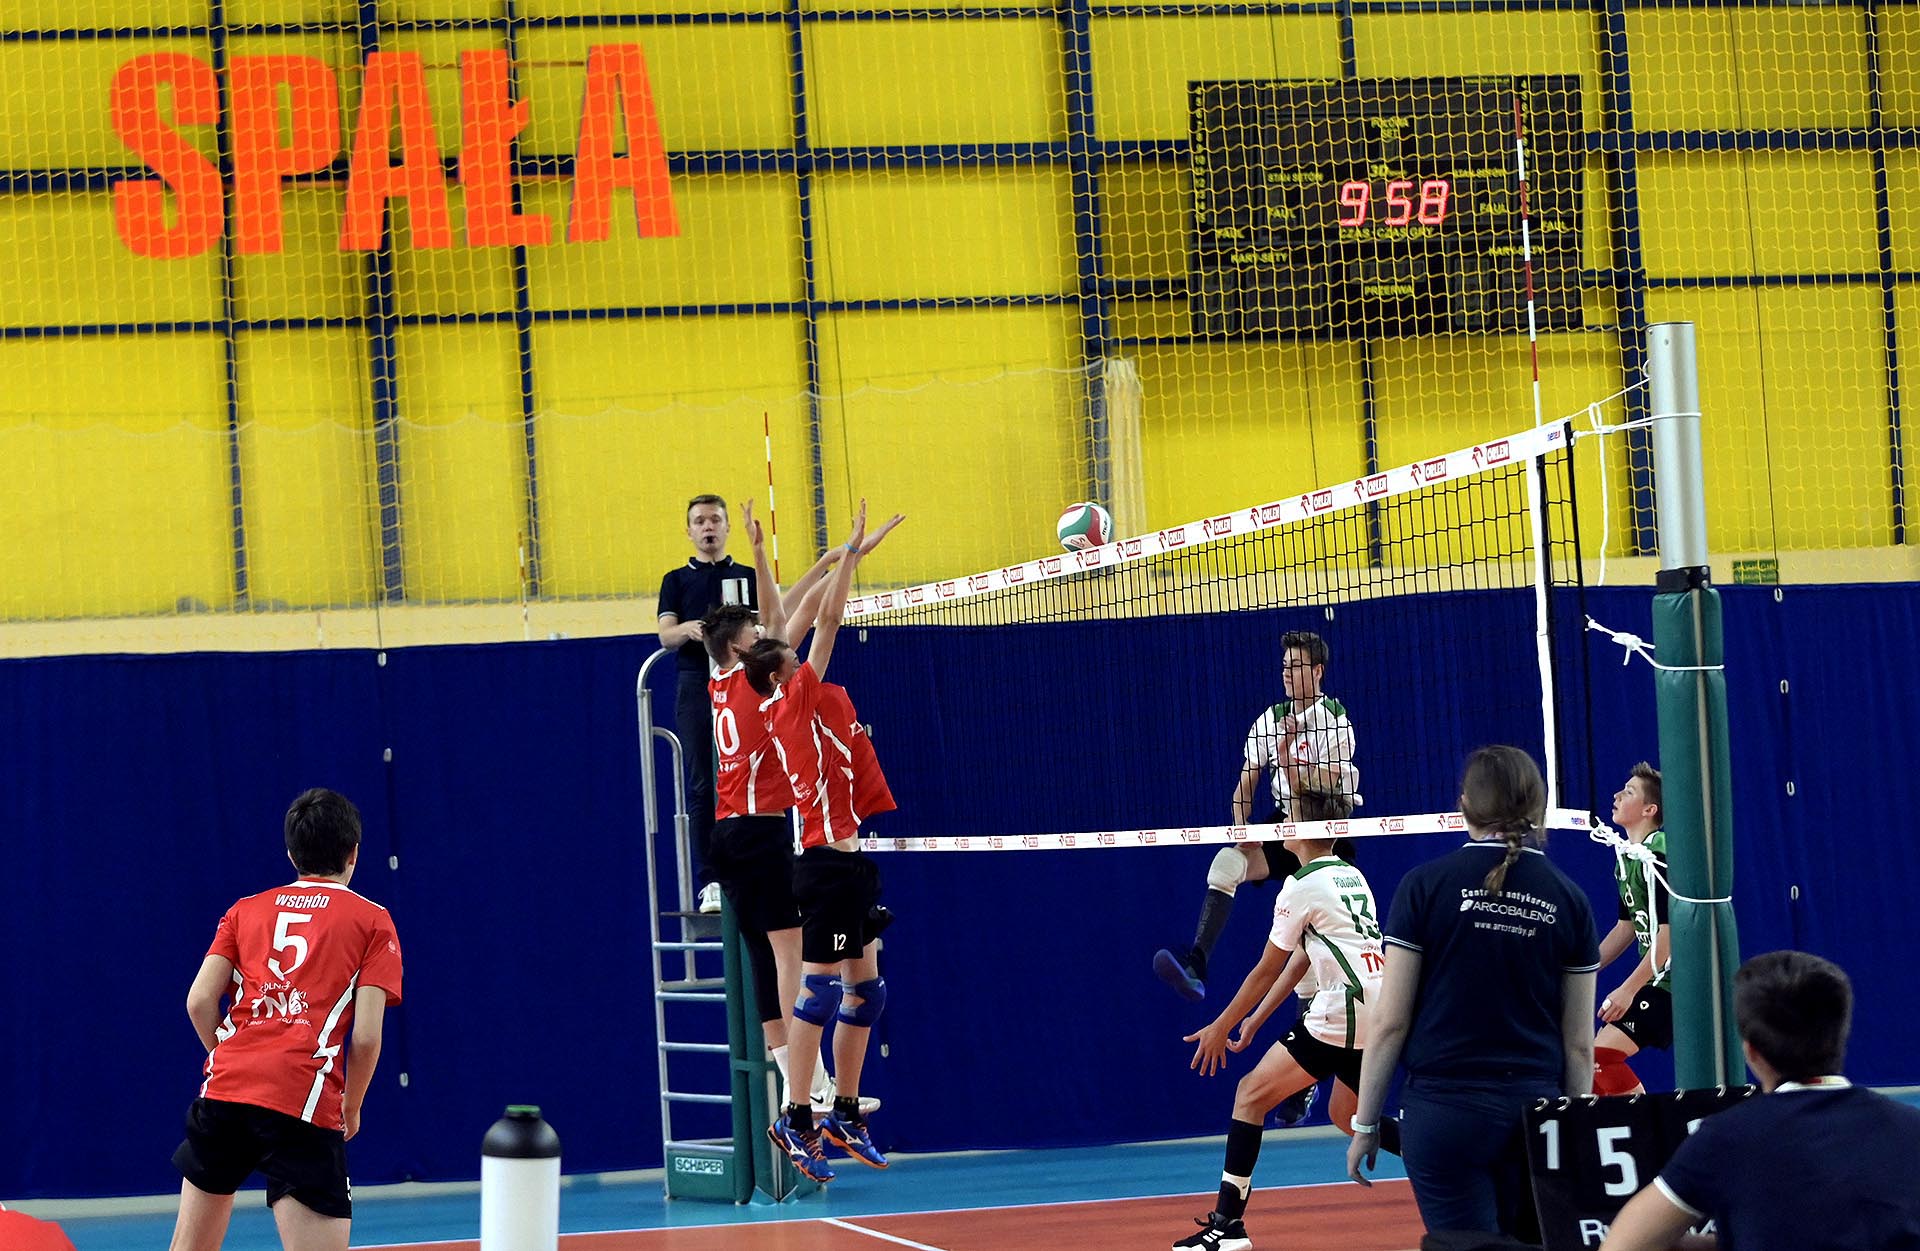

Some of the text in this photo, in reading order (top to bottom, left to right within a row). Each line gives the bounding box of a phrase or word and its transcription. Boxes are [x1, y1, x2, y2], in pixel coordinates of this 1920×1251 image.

[110, 43, 681, 260] SPAŁA
[1340, 181, 1369, 226] 9
[1486, 442, 1509, 463] ORLEN
[1424, 460, 1446, 480] ORLEN
[1367, 476, 1387, 496] ORLEN
[1313, 491, 1332, 510] ORLEN
[274, 893, 331, 909] WSCHÓD
[1340, 894, 1382, 940] 13
[1472, 901, 1556, 925] ARCOBALENO
[268, 911, 313, 981] 5
[833, 933, 847, 951] 12
[1538, 1119, 1639, 1197] 1 5
